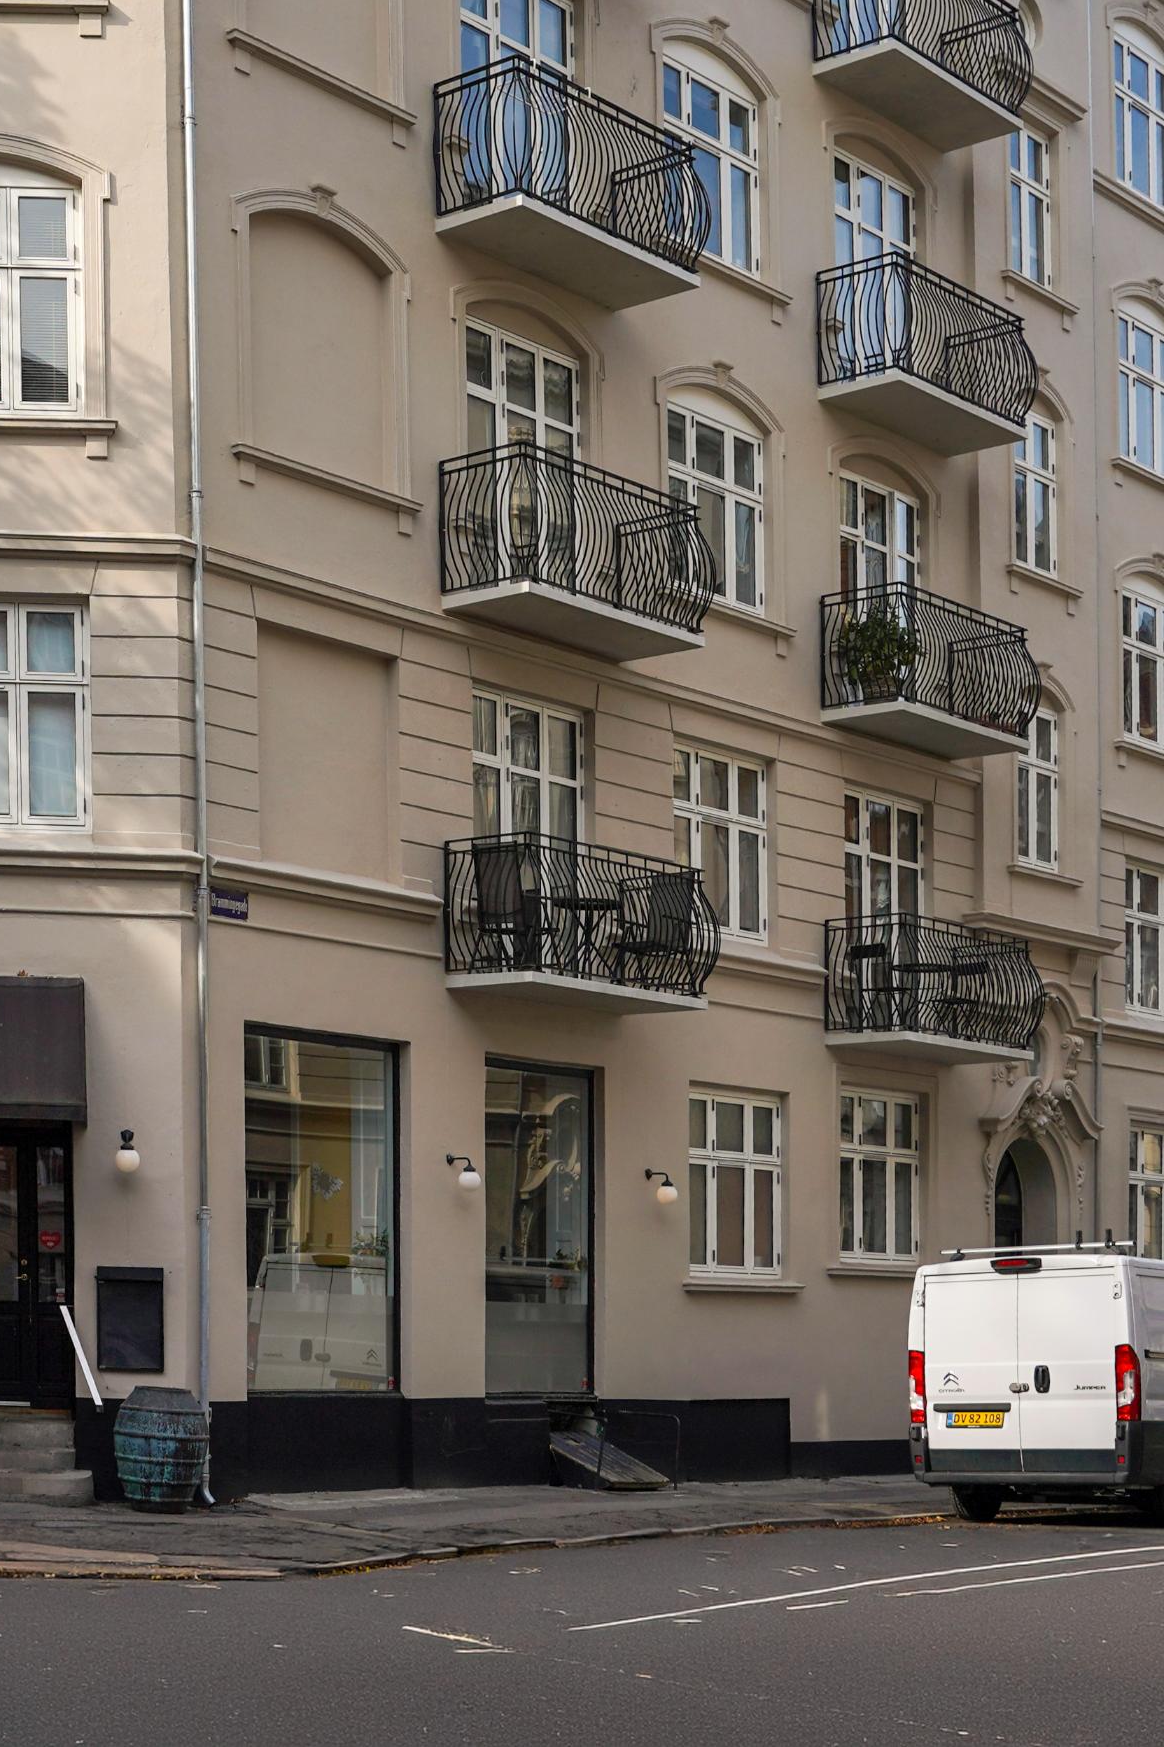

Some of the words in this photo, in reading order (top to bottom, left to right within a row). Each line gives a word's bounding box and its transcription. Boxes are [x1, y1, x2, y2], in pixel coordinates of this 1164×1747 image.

[954, 1414, 967, 1423] DV
[968, 1414, 981, 1424] 82
[983, 1414, 1001, 1423] 108
